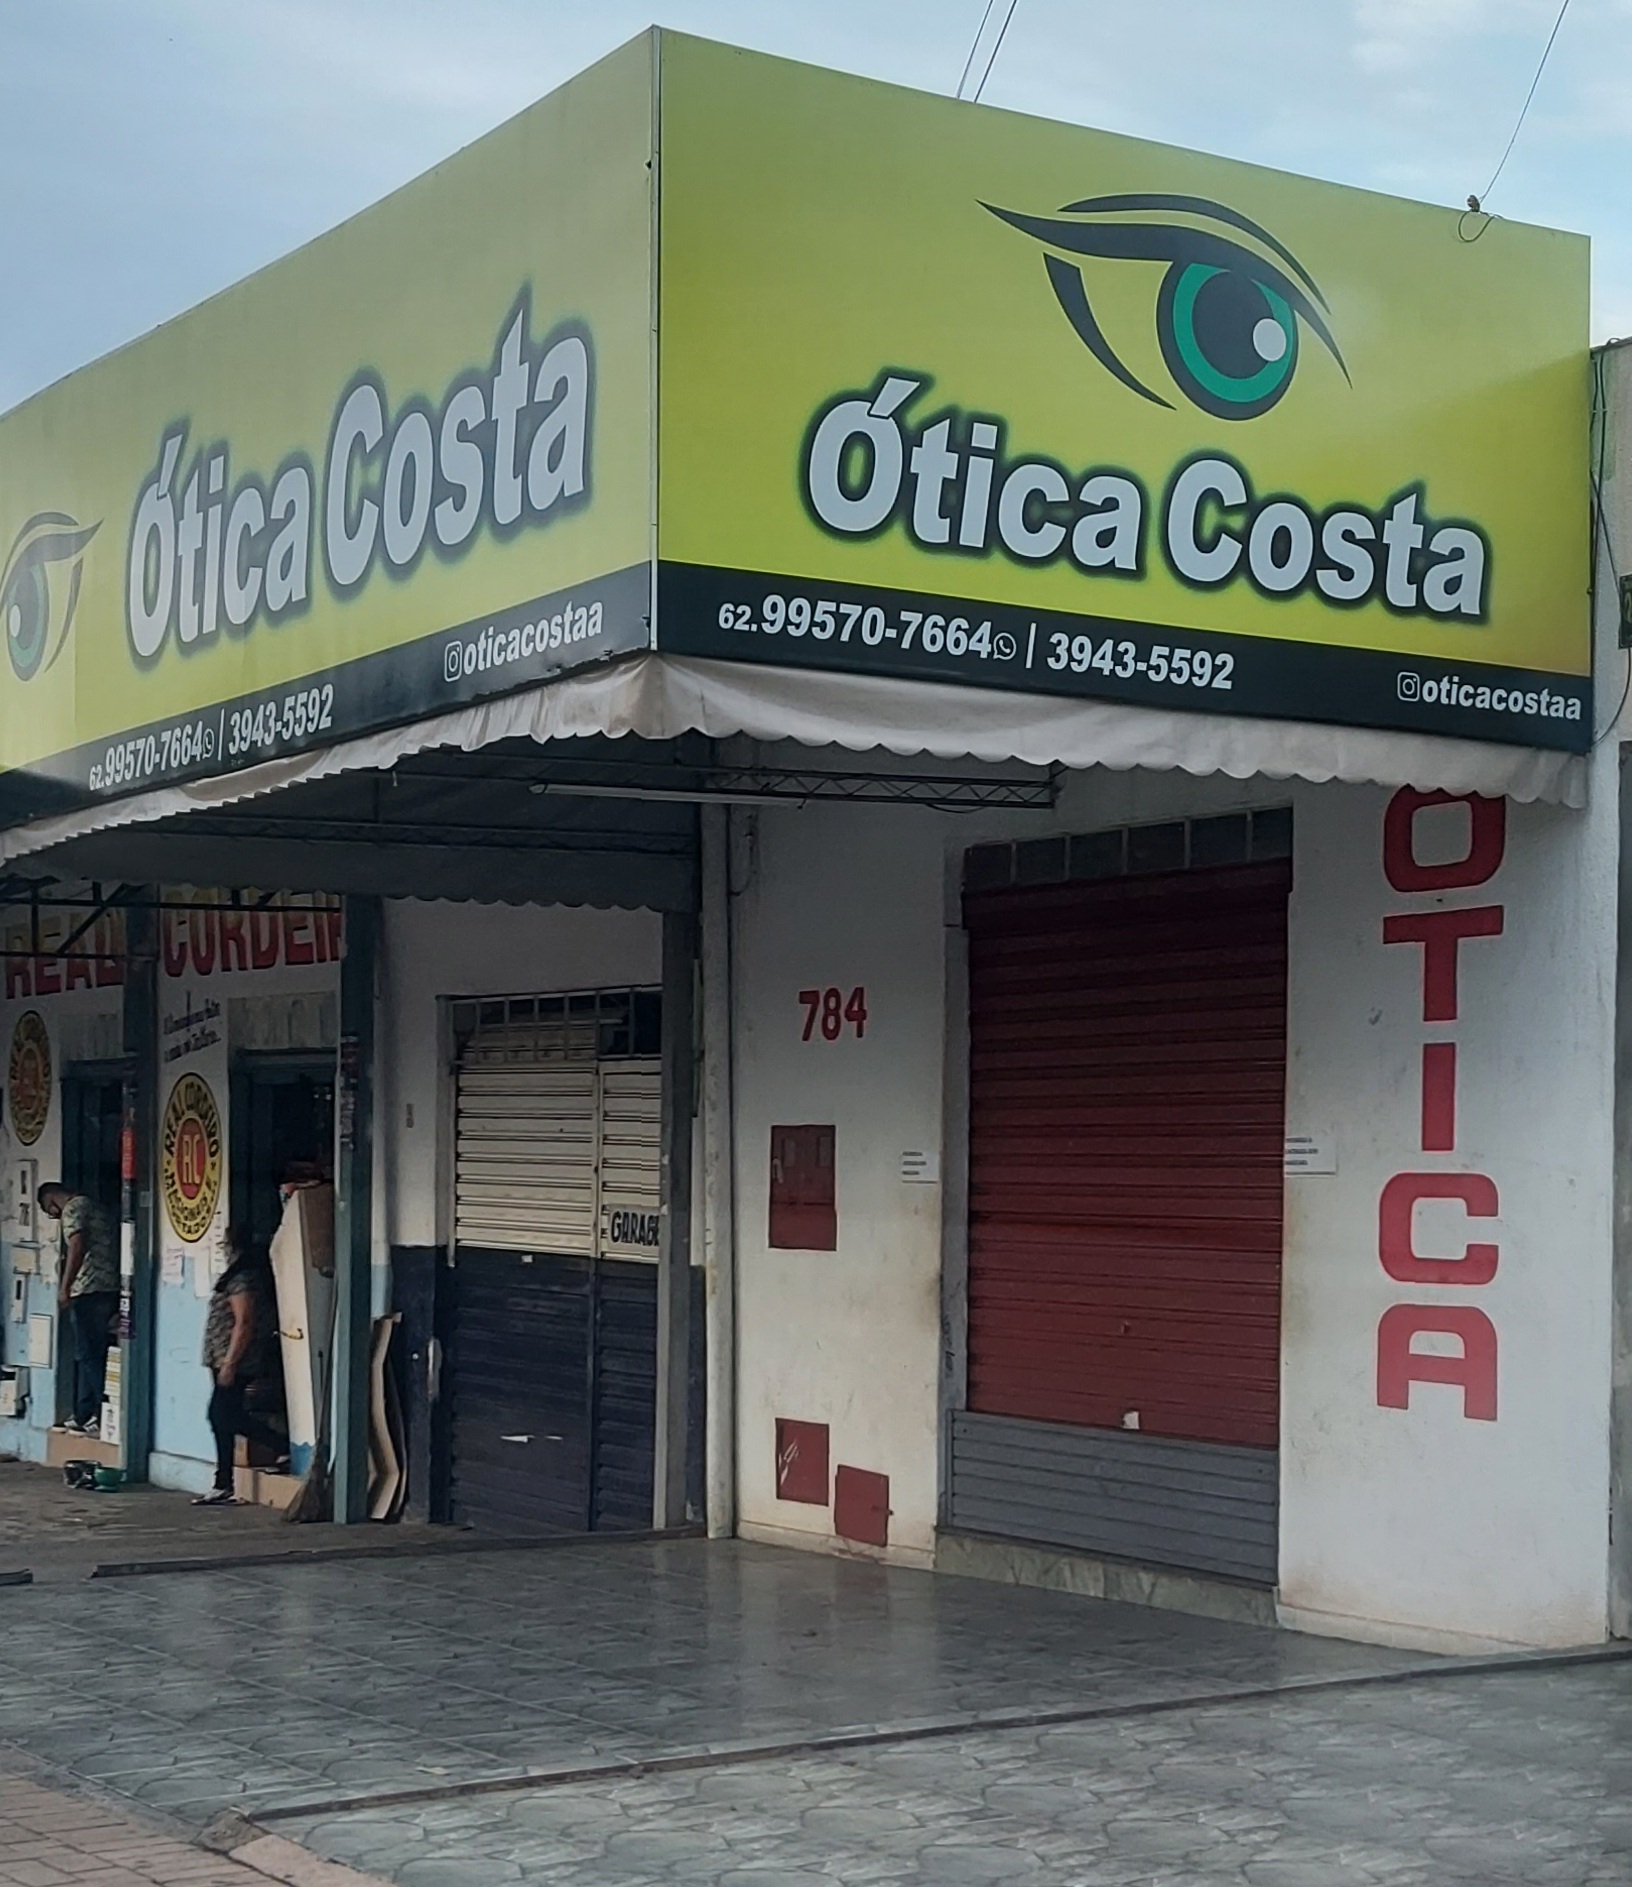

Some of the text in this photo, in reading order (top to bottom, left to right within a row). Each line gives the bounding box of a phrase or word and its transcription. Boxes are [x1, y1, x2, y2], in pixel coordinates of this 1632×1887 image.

[129, 309, 588, 657] Ótica Costa
[808, 378, 1486, 610] Ótica Costa
[463, 602, 603, 676] oticacostaa
[717, 594, 1236, 691] 62.99570-7664 3943-5592
[228, 684, 334, 756] 3943-5592
[1421, 673, 1582, 722] oticacostaa
[799, 987, 867, 1041] 784
[1376, 783, 1506, 1422] OTICA
